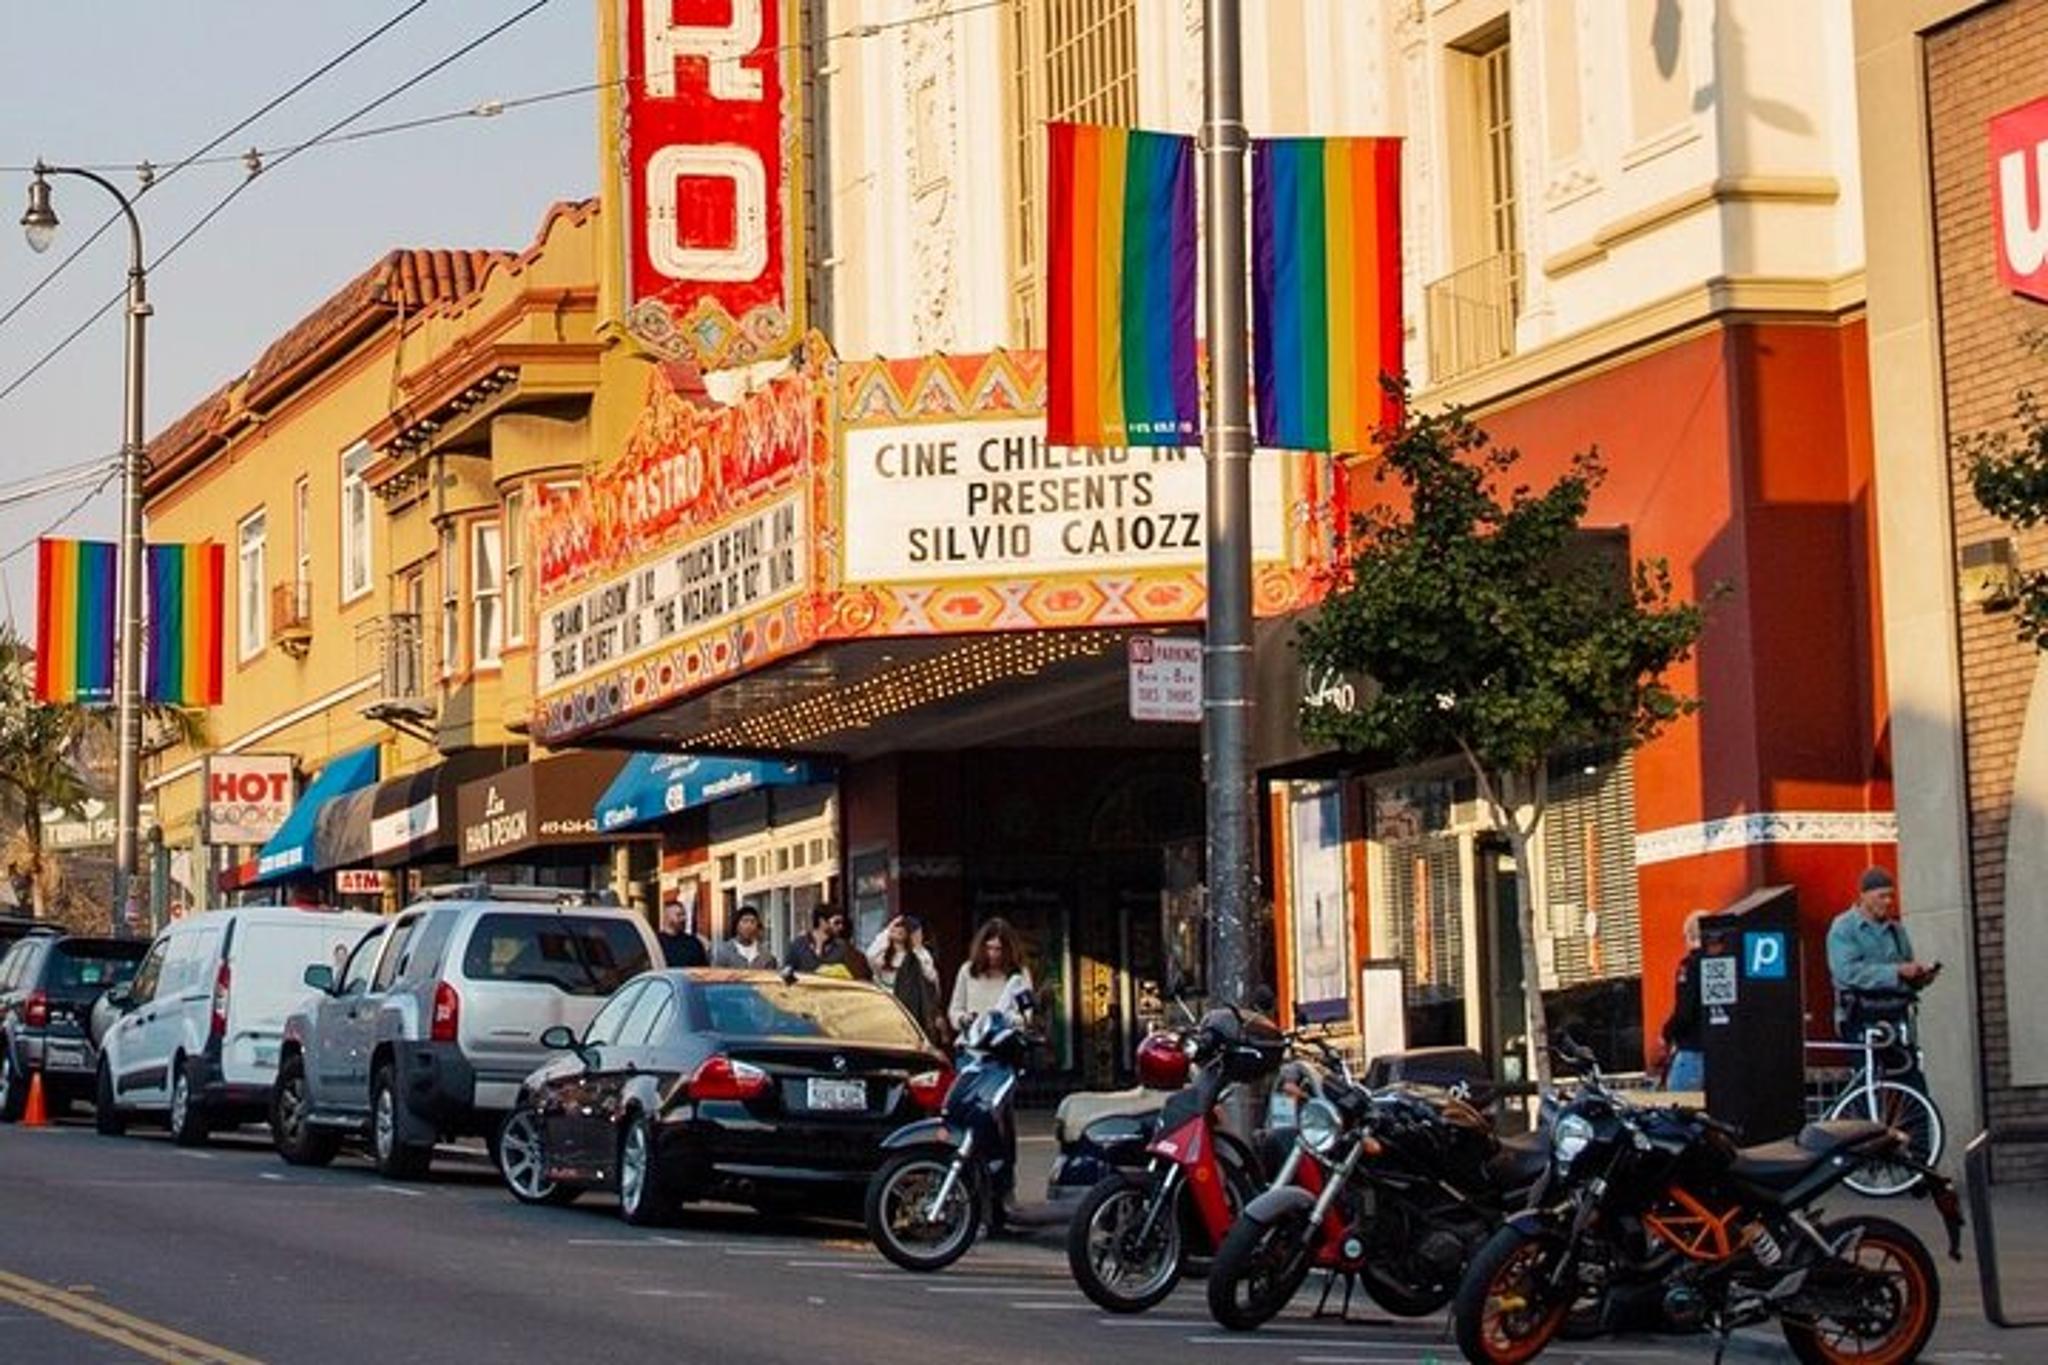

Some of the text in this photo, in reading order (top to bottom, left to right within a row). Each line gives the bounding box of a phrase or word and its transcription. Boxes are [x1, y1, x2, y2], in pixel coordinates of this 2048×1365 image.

[875, 442, 957, 479] CINE
[621, 444, 703, 530] CASTRO
[967, 472, 1153, 517] PRESENTS
[909, 526, 1031, 562] SILVIO
[1156, 645, 1199, 662] PARKING
[211, 772, 289, 803] HOT
[342, 872, 380, 889] ATM
